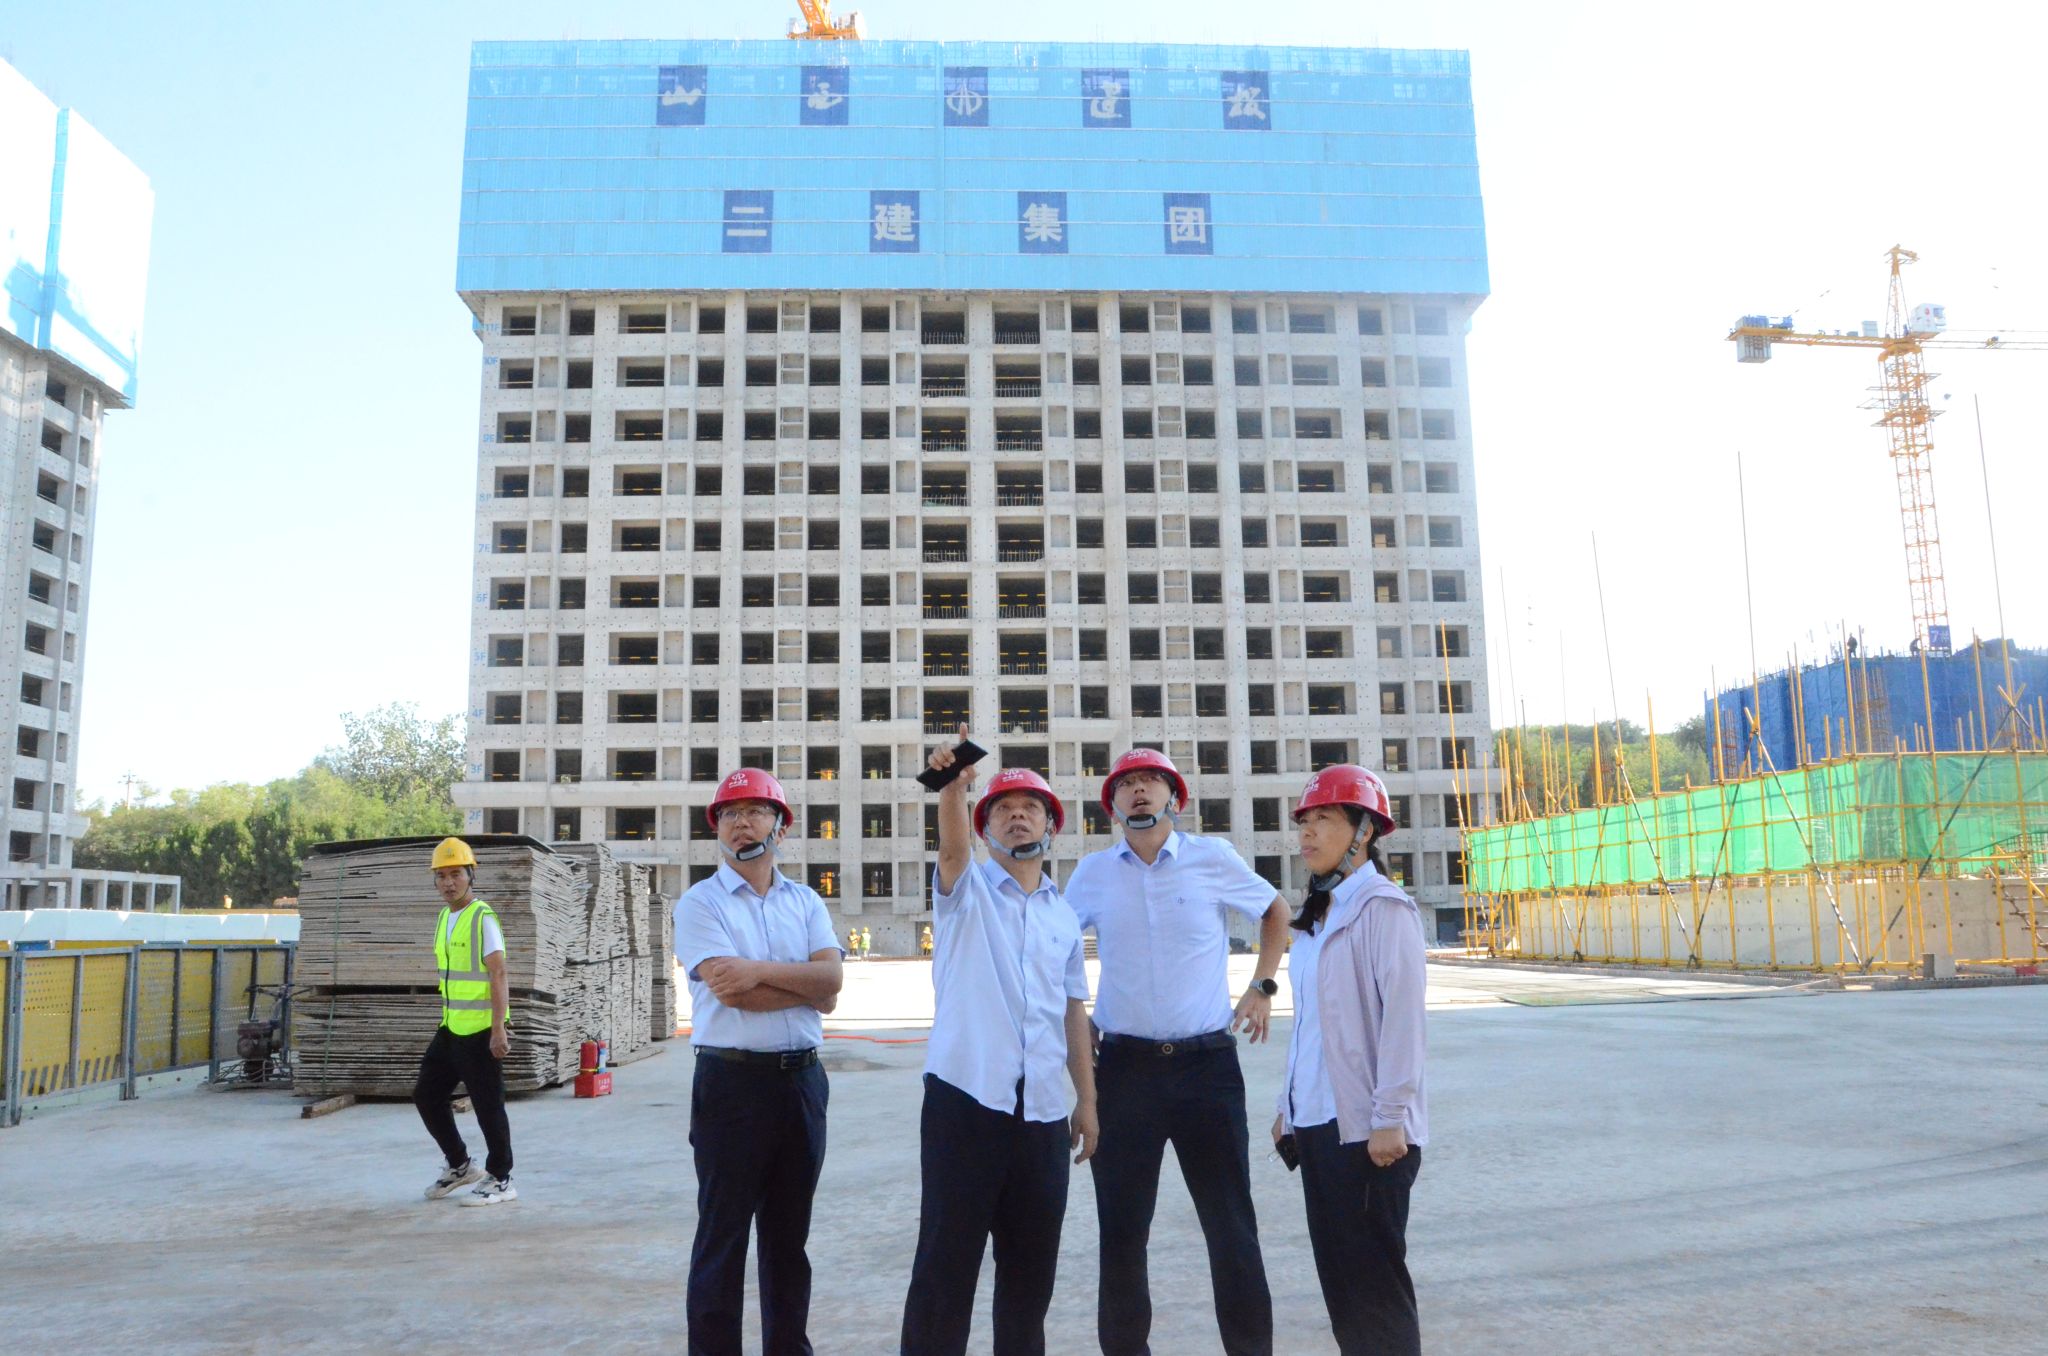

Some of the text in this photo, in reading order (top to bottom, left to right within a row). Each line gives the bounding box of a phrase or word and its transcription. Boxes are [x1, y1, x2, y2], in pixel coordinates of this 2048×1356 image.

[727, 202, 1207, 244] 二建集团
[472, 708, 485, 718] 4F
[470, 763, 482, 774] 3F
[468, 810, 482, 821] 2F
